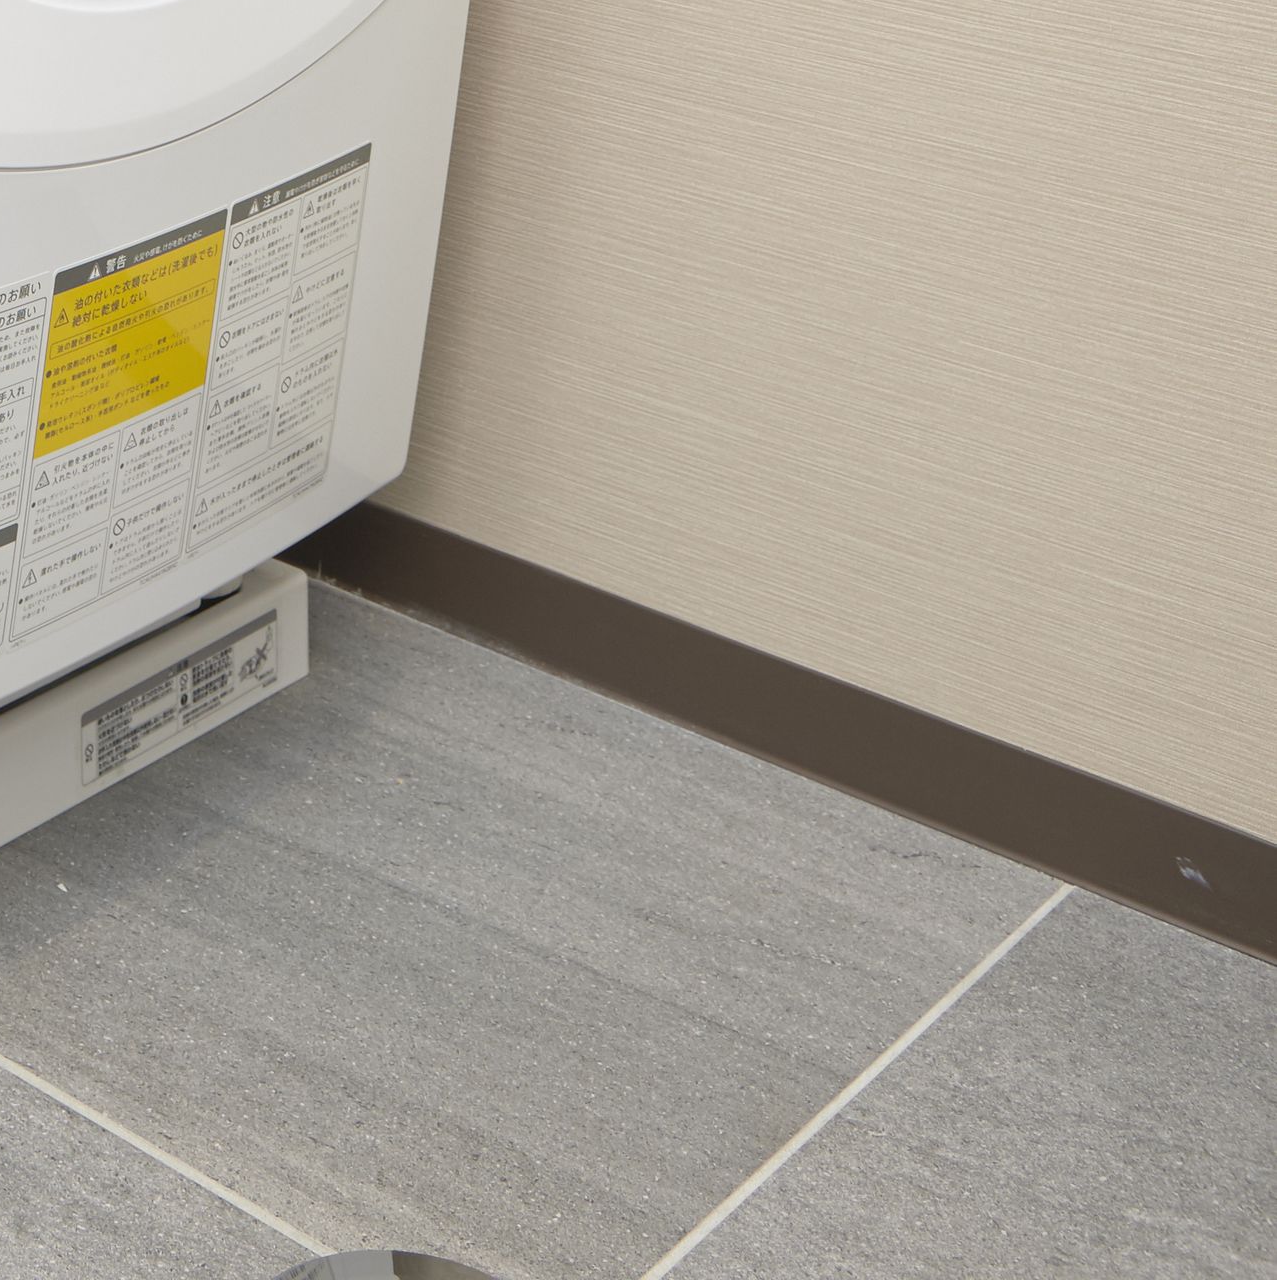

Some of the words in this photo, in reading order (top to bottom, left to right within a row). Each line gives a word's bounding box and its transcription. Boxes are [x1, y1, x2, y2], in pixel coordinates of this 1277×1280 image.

[262, 189, 280, 209] 注意
[105, 253, 126, 275] 警告
[71, 288, 147, 329] 絶対に乾燥しない
